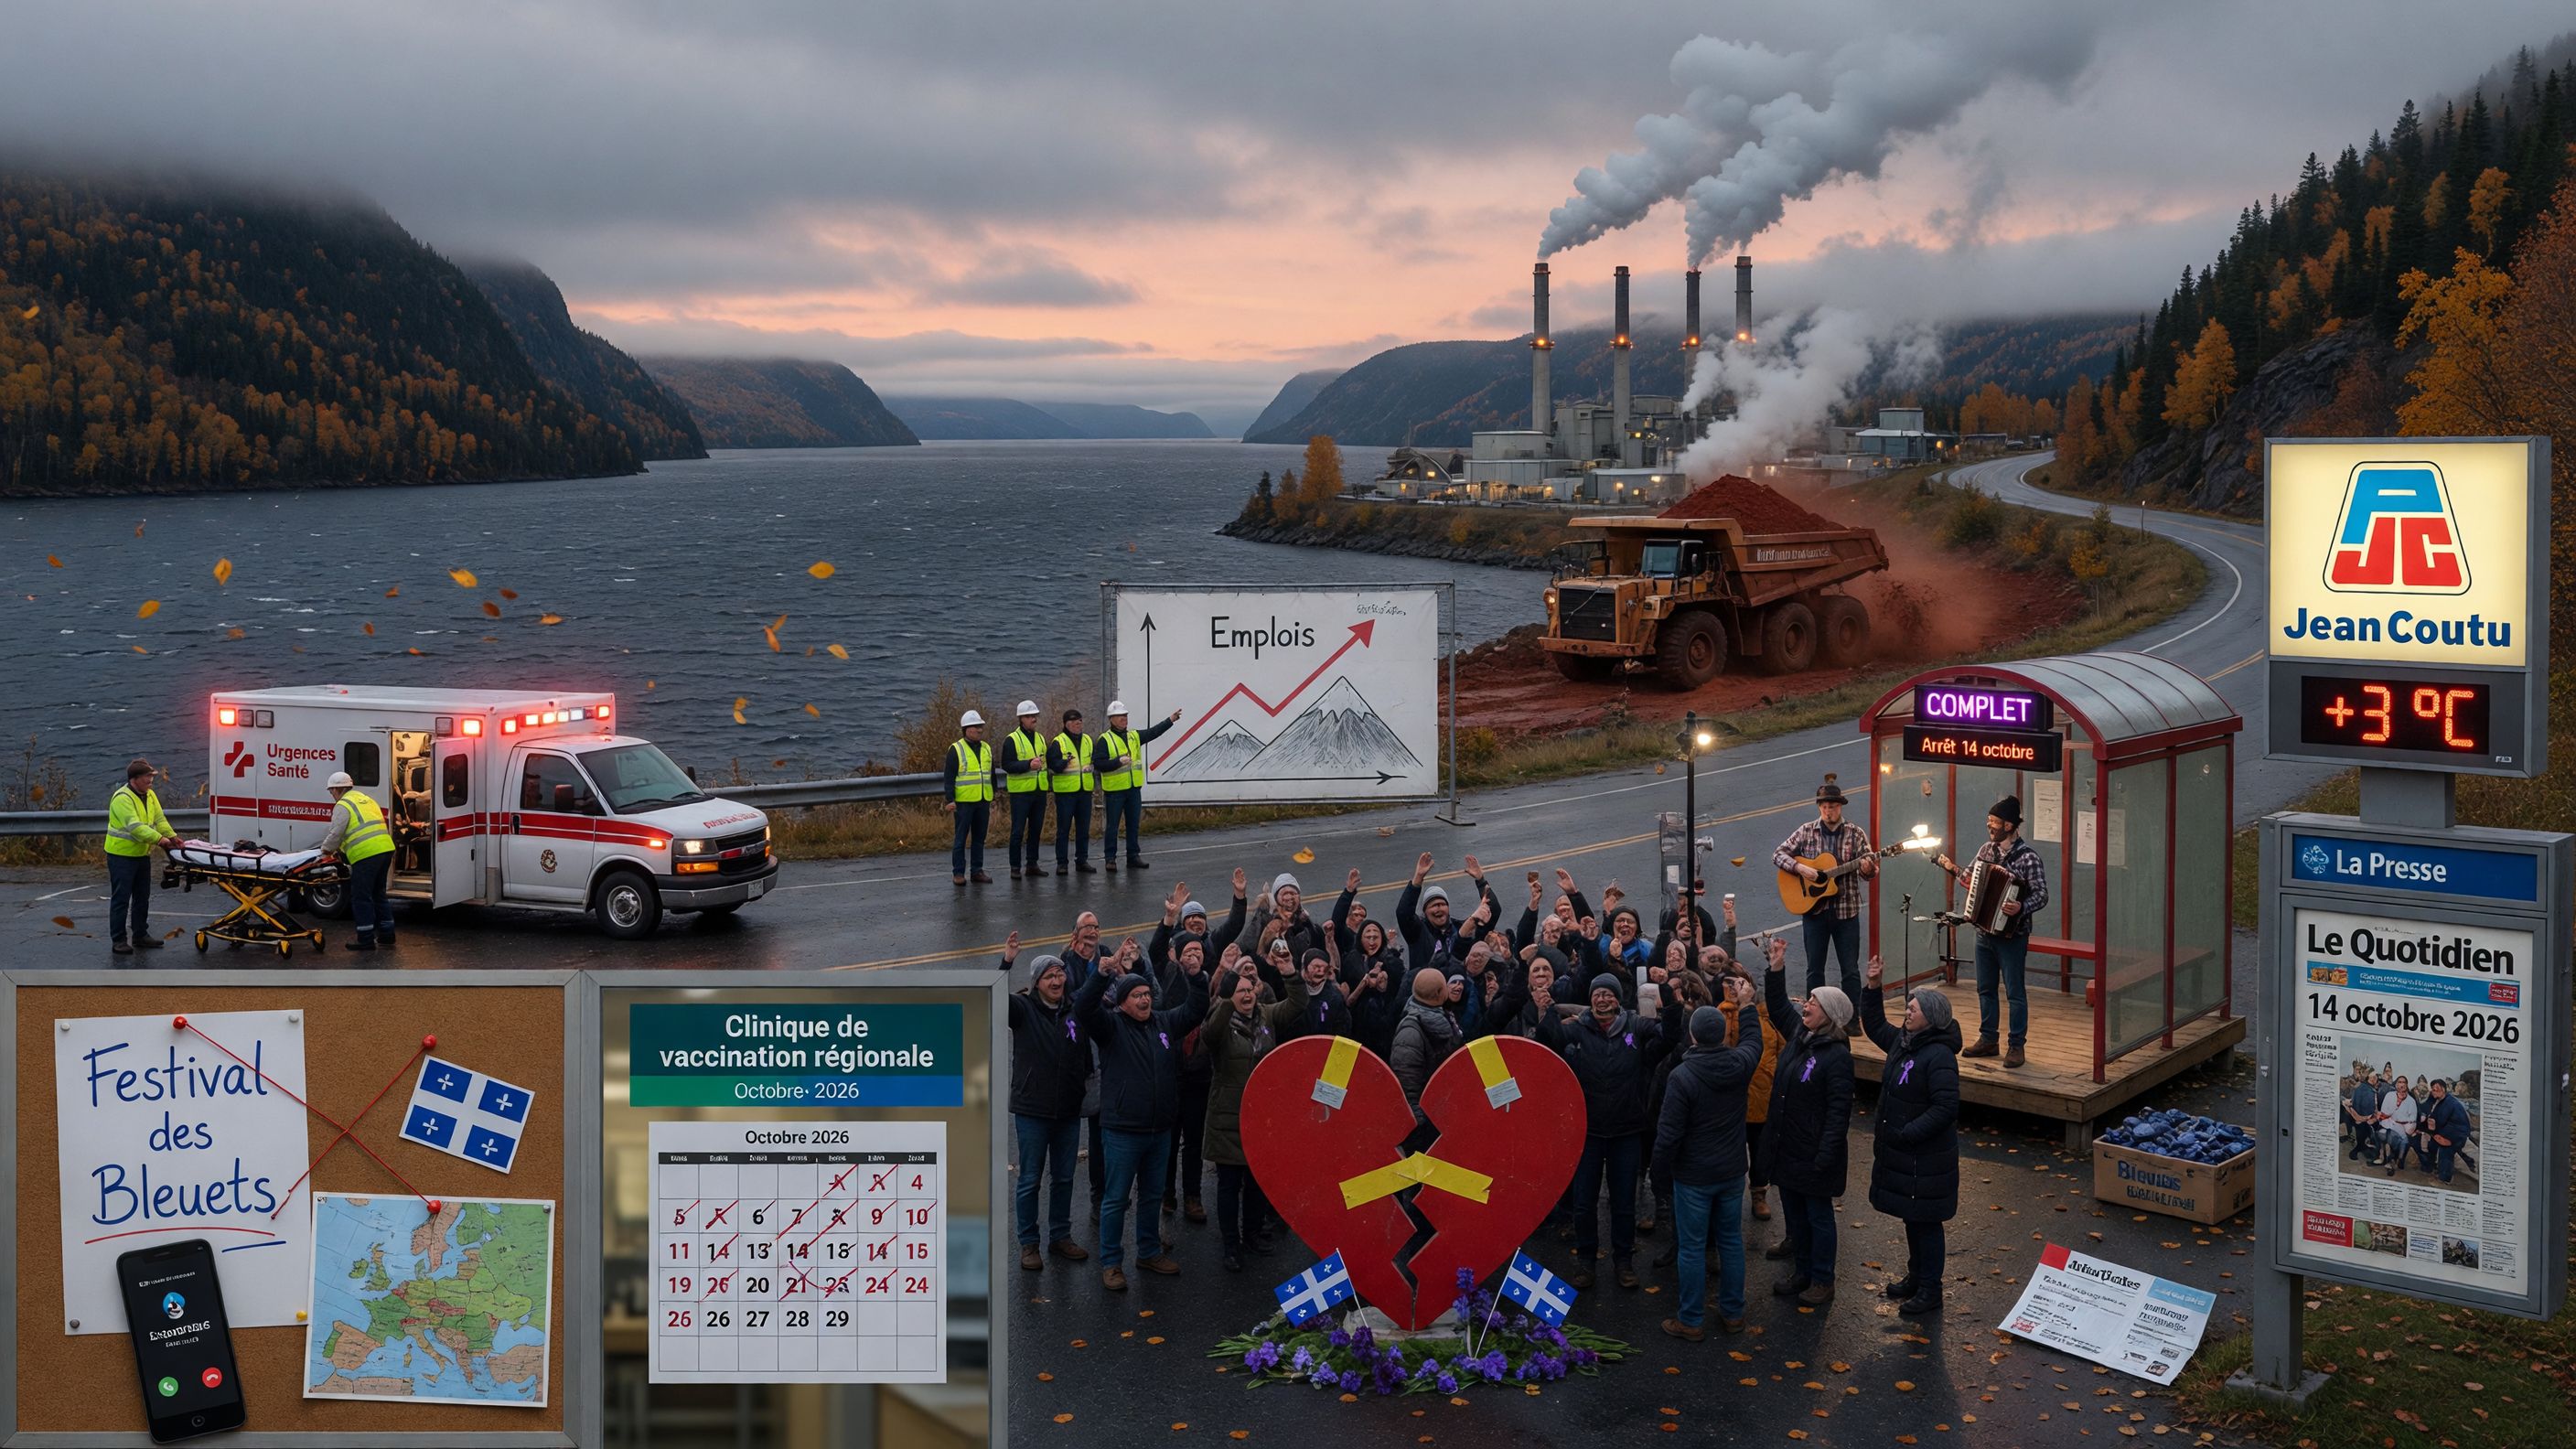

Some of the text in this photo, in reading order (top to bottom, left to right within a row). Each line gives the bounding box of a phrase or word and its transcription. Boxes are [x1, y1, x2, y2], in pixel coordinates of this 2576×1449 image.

[1210, 616, 1315, 660] Emplois
[2283, 607, 2511, 648] Jean Coutu
[1927, 692, 2032, 722] COMPLET
[2325, 685, 2391, 742] +3
[267, 744, 336, 762] Urgences
[1961, 740, 1978, 757] 14
[1982, 743, 2034, 760] octobre
[267, 762, 309, 778] Santé
[2336, 849, 2447, 883] La Presse
[2308, 924, 2514, 975] Le Quotidien
[724, 1014, 868, 1043] Clinique de
[2308, 993, 2519, 1045] 14 octobre 2026
[660, 1045, 934, 1072] vaccination régionale
[83, 1040, 268, 1108] Festival
[814, 1083, 859, 1099] 2026
[149, 1111, 213, 1152] des
[746, 1131, 850, 1144] Octobre 2026
[91, 1158, 276, 1225] Bleuets
[911, 1175, 923, 1190] 4
[753, 1208, 764, 1225] 6
[871, 1208, 883, 1225] 9
[906, 1208, 928, 1226] 10
[670, 1242, 689, 1260] 11
[669, 1277, 691, 1293] 19
[746, 1277, 769, 1293] 20
[865, 1277, 888, 1293] 24
[905, 1277, 928, 1293] 24
[668, 1311, 849, 1327] 26 26 27 28 29
